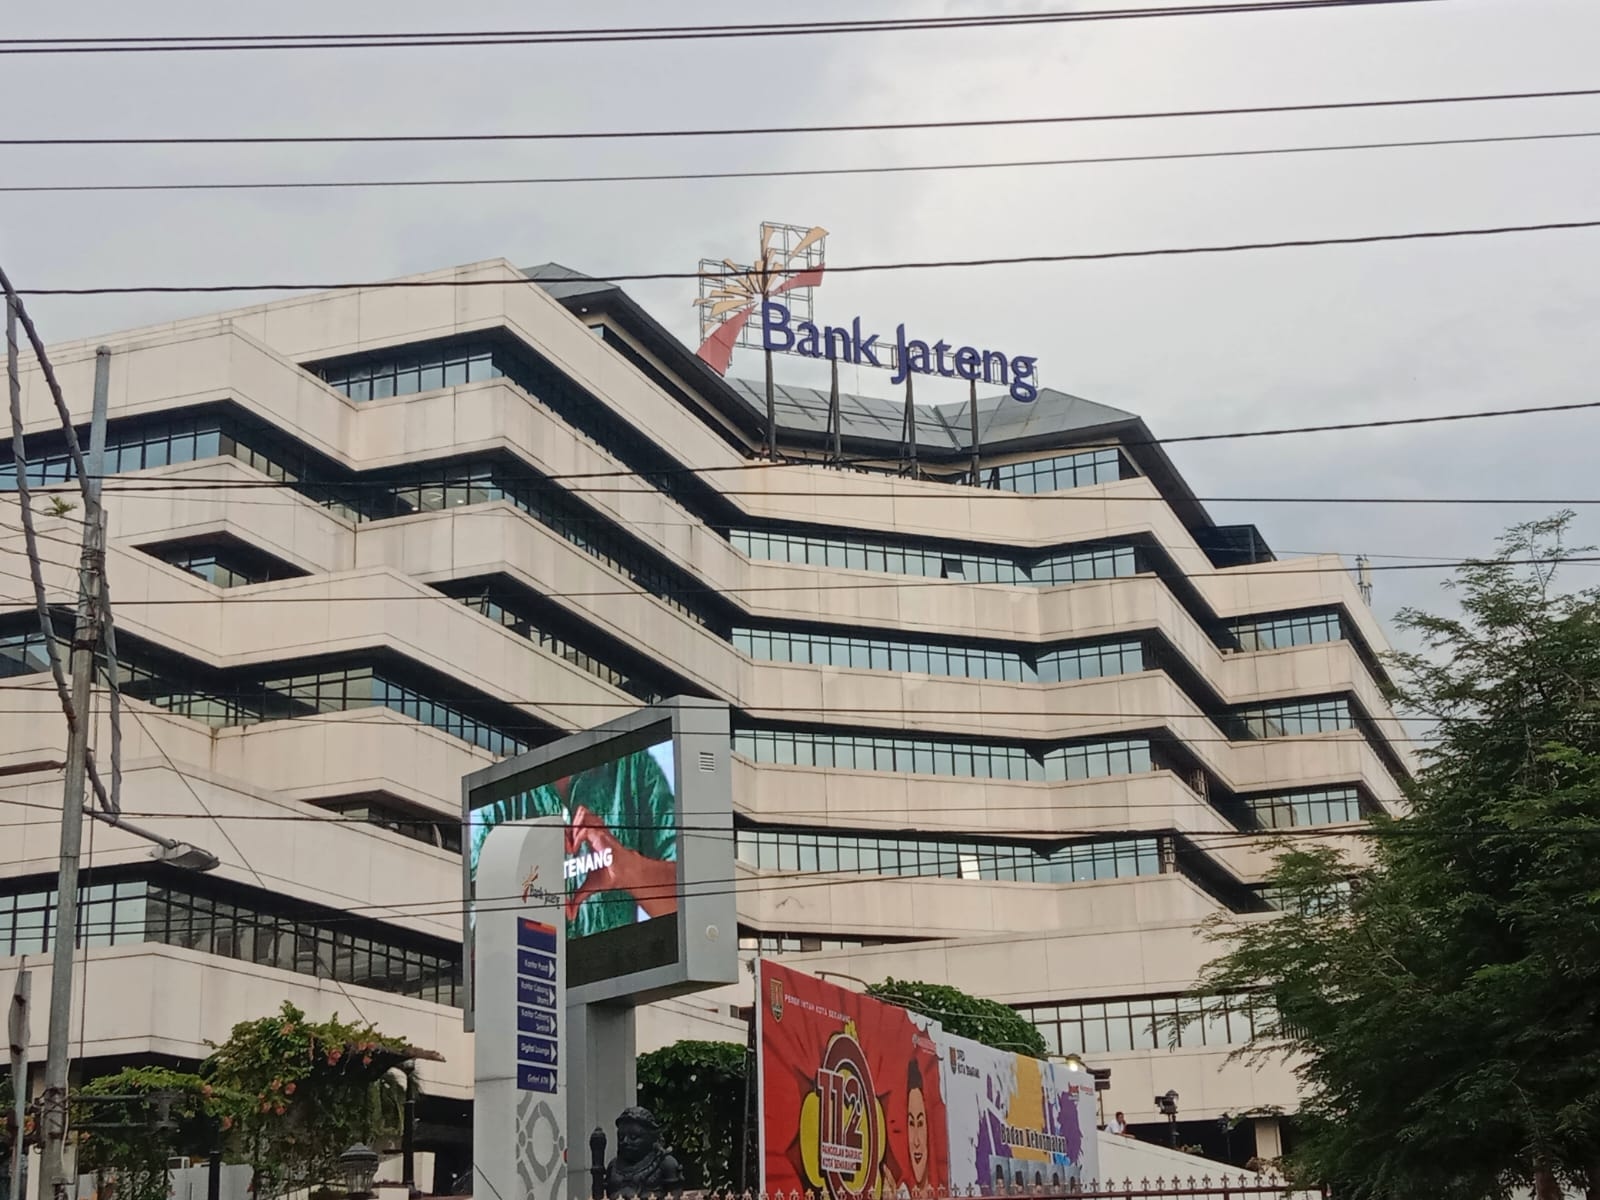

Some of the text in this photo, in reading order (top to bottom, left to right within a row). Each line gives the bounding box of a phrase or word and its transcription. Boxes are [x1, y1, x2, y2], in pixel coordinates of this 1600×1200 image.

[762, 302, 1038, 403] Bank Jateng
[563, 847, 613, 880] TENANG
[818, 1068, 864, 1150] 112
[1000, 1123, 1024, 1147] Badan
